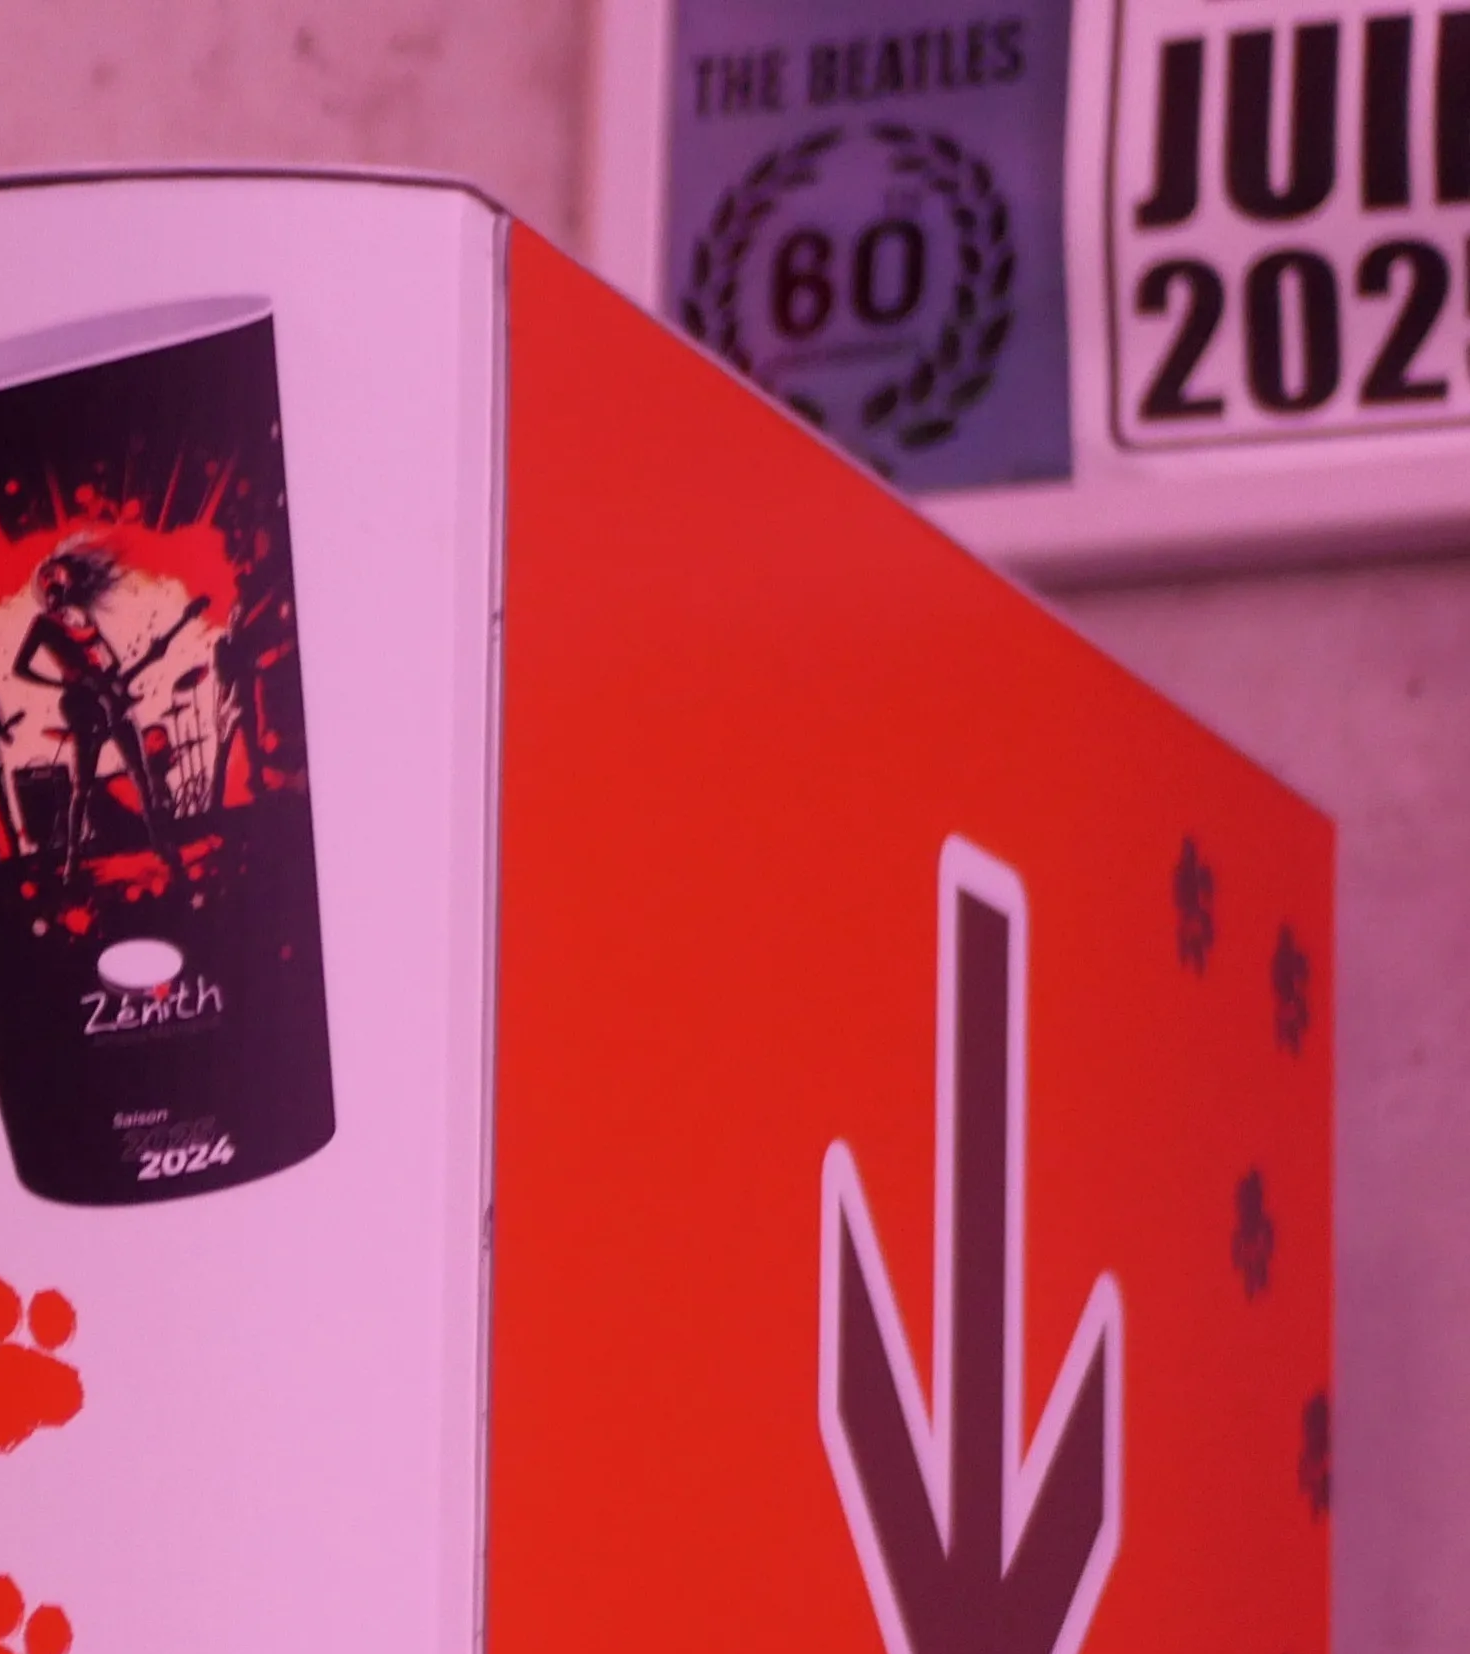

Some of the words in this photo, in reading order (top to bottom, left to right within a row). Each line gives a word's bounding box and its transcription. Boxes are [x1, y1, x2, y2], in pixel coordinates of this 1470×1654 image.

[695, 49, 787, 115] THE
[808, 16, 1026, 106] BEATLES
[770, 219, 927, 339] 60
[1136, 237, 1470, 421] 202
[114, 1109, 168, 1128] Saison
[139, 1136, 234, 1179] 2024
